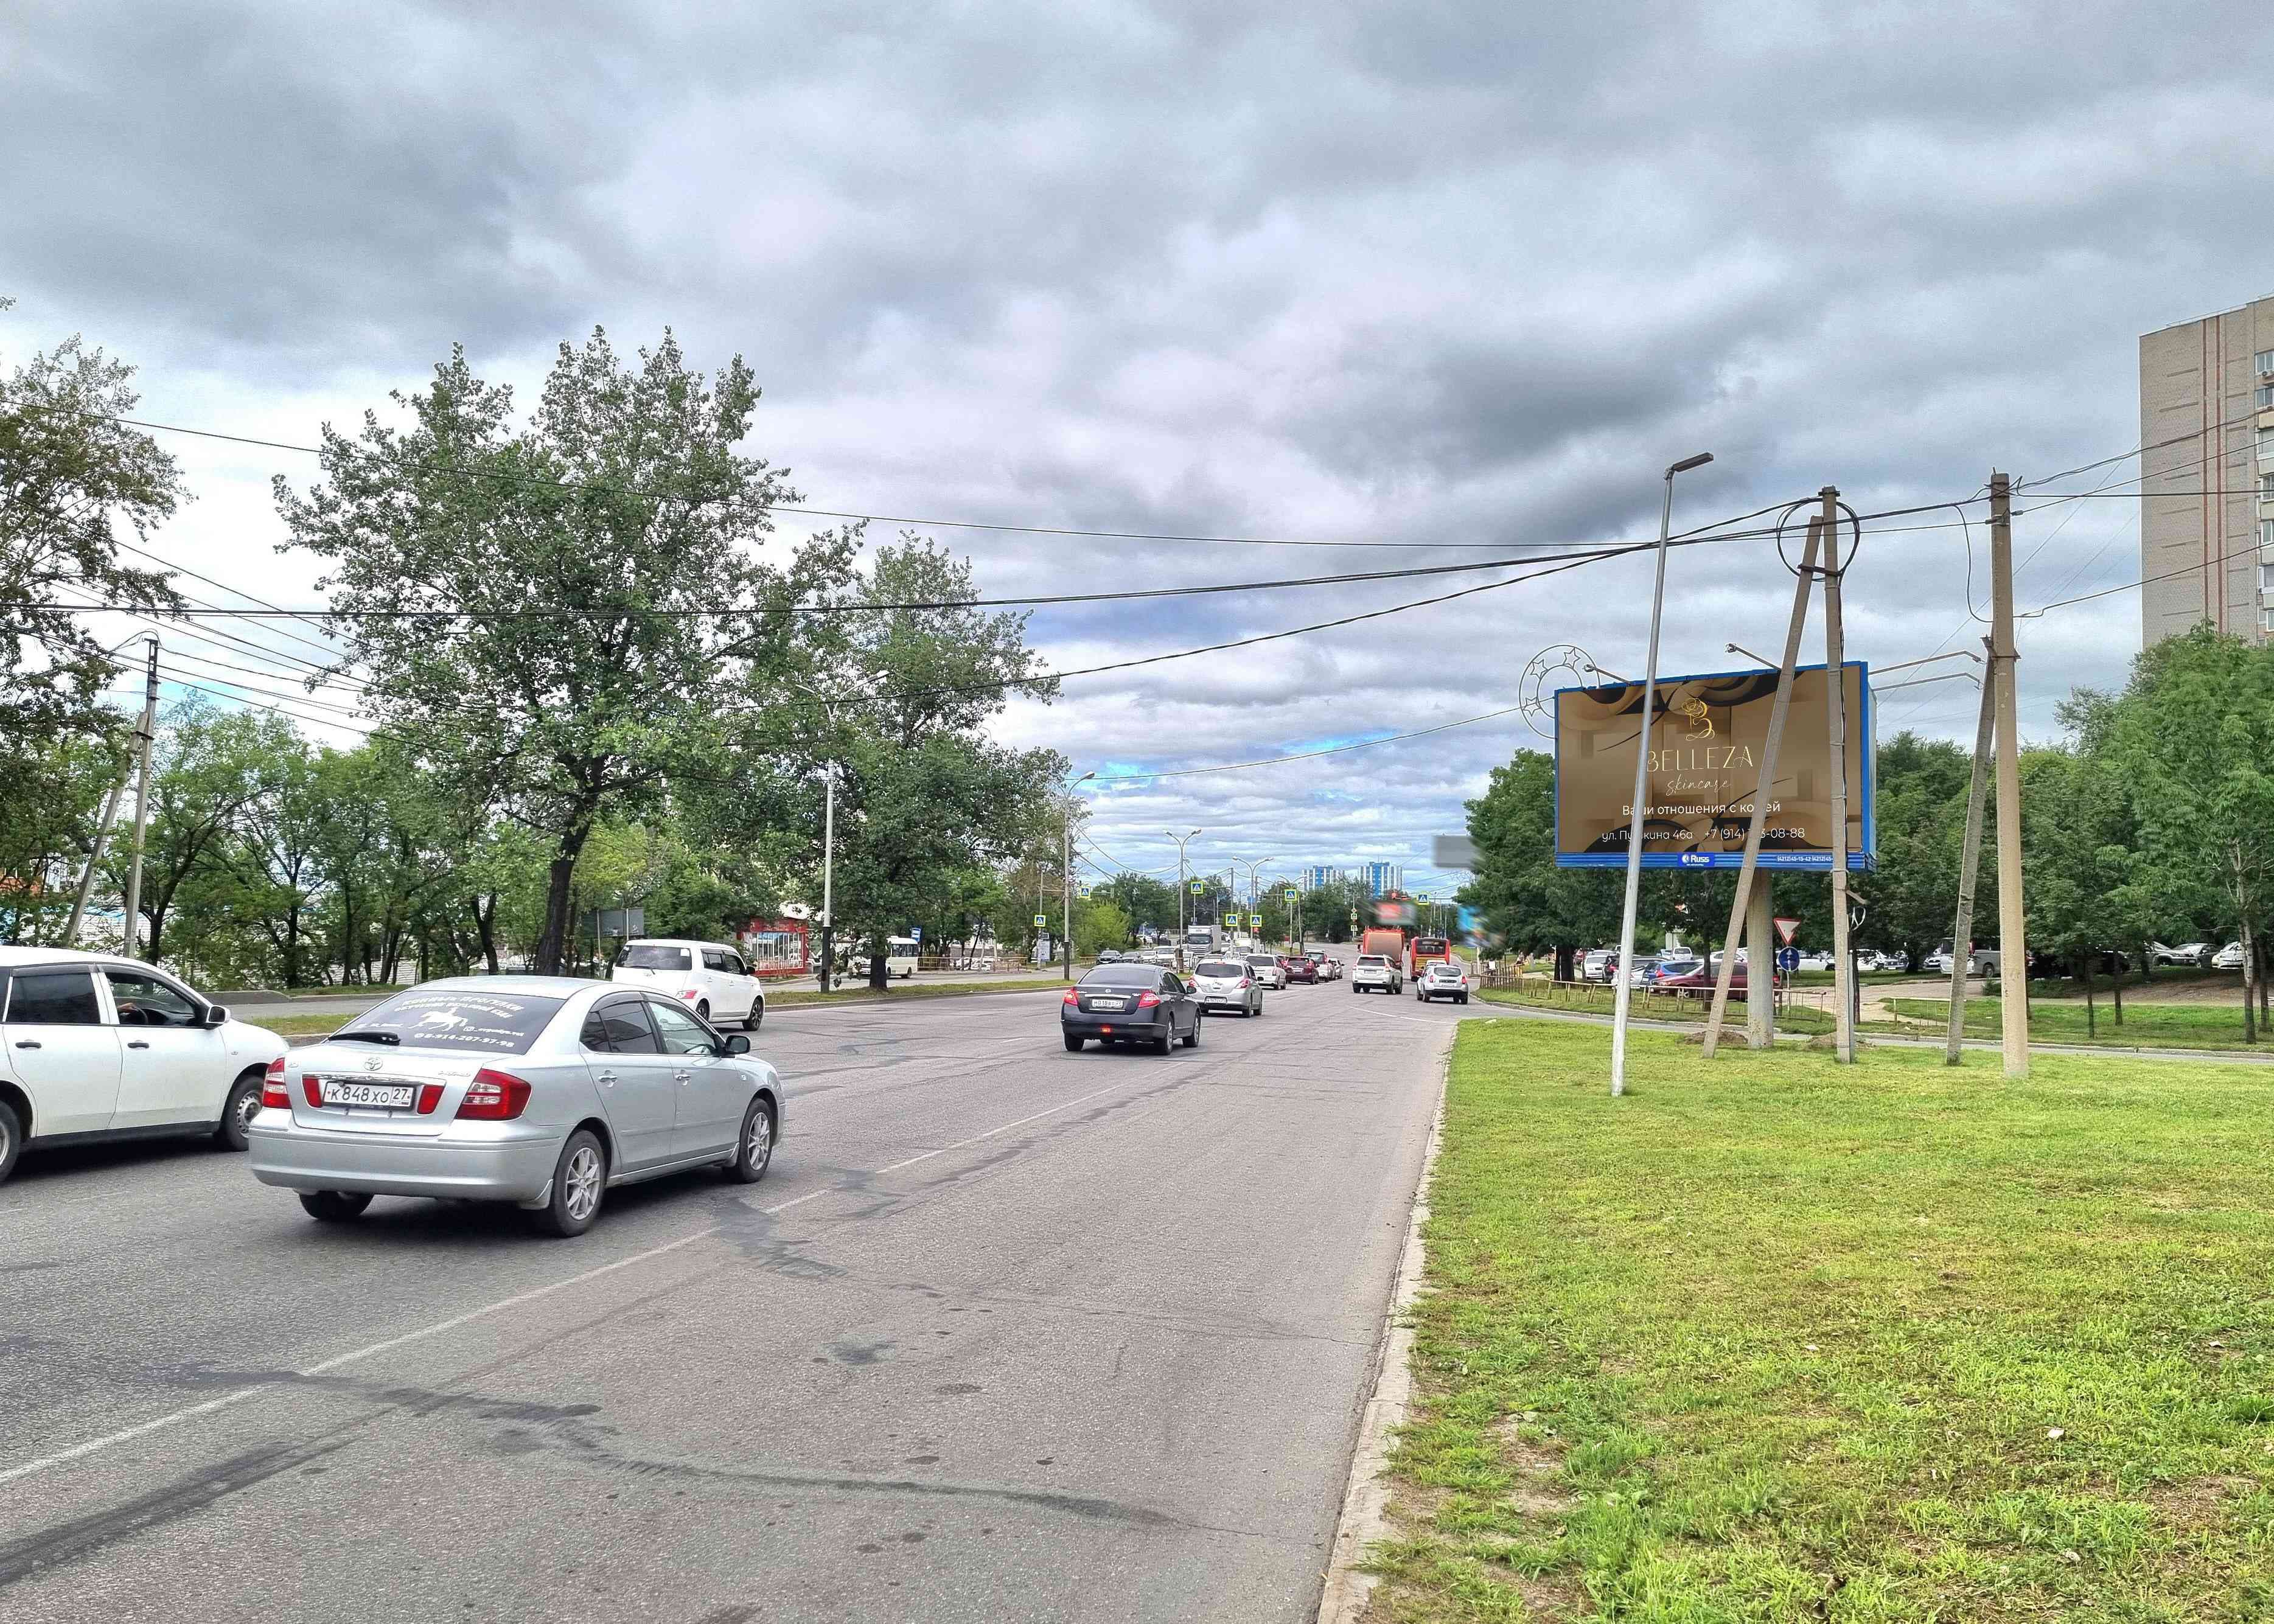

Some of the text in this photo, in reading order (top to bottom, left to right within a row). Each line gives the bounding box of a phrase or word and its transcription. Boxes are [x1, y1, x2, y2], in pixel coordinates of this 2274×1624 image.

[1647, 746, 1753, 772] BELLEZA
[1665, 774, 1732, 796] skincare
[1622, 801, 1780, 815] Ваи отношения с коей
[1602, 832, 1617, 842] ул.
[1619, 831, 1670, 842] Пукина
[1705, 828, 1717, 839] +7
[1720, 828, 1745, 841] (914)
[1690, 854, 1710, 863] Russ
[393, 1088, 408, 1100] 27
